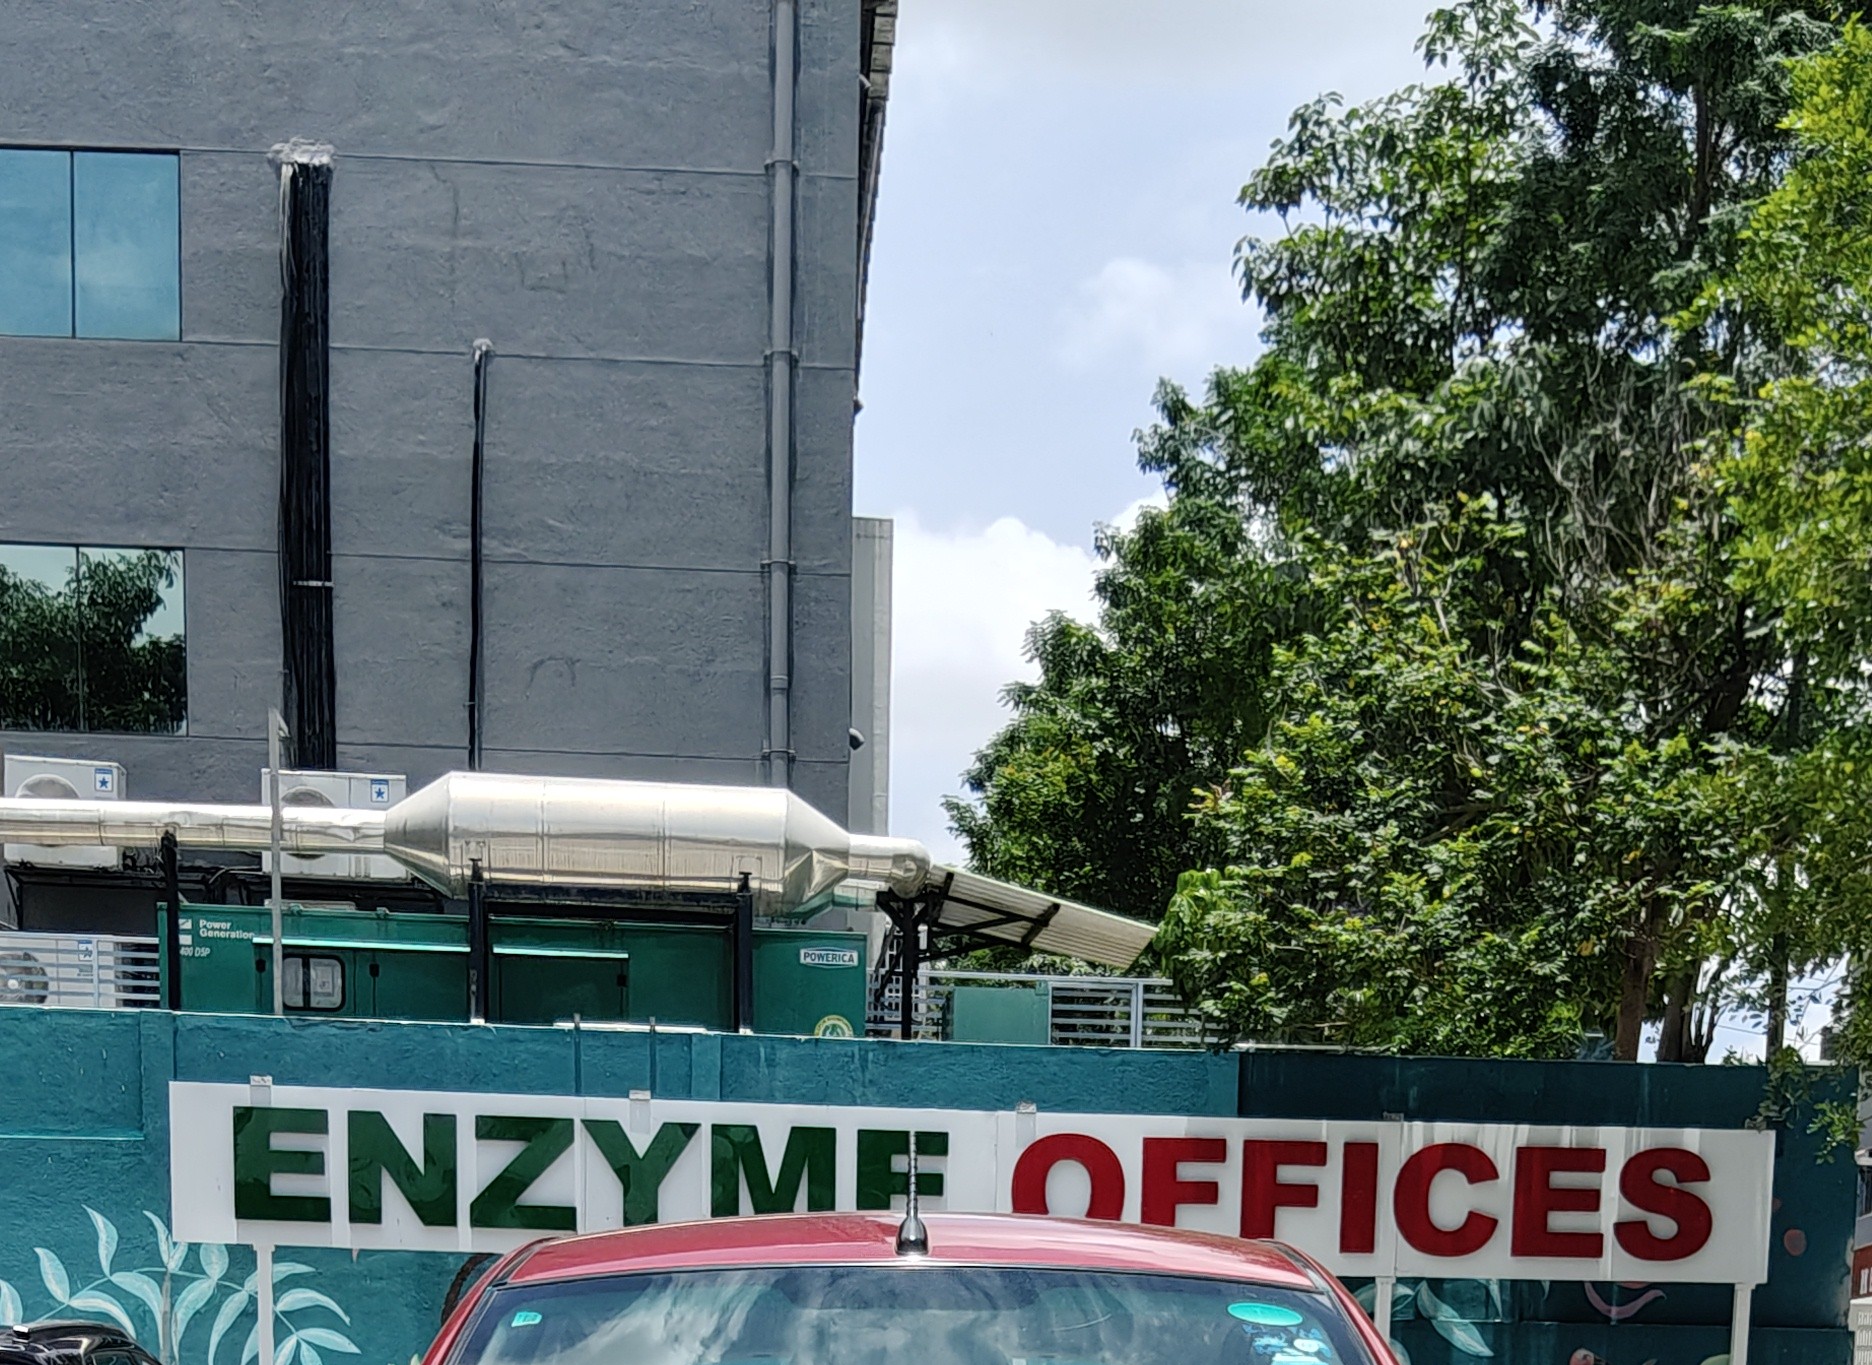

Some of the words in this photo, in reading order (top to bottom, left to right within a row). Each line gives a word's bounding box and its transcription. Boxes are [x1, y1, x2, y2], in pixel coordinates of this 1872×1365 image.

[199, 919, 232, 930] Power
[199, 928, 255, 940] Generation
[803, 951, 855, 964] POWERICA
[233, 1105, 949, 1232] ENZYME
[1010, 1132, 1713, 1261] OFFICES
